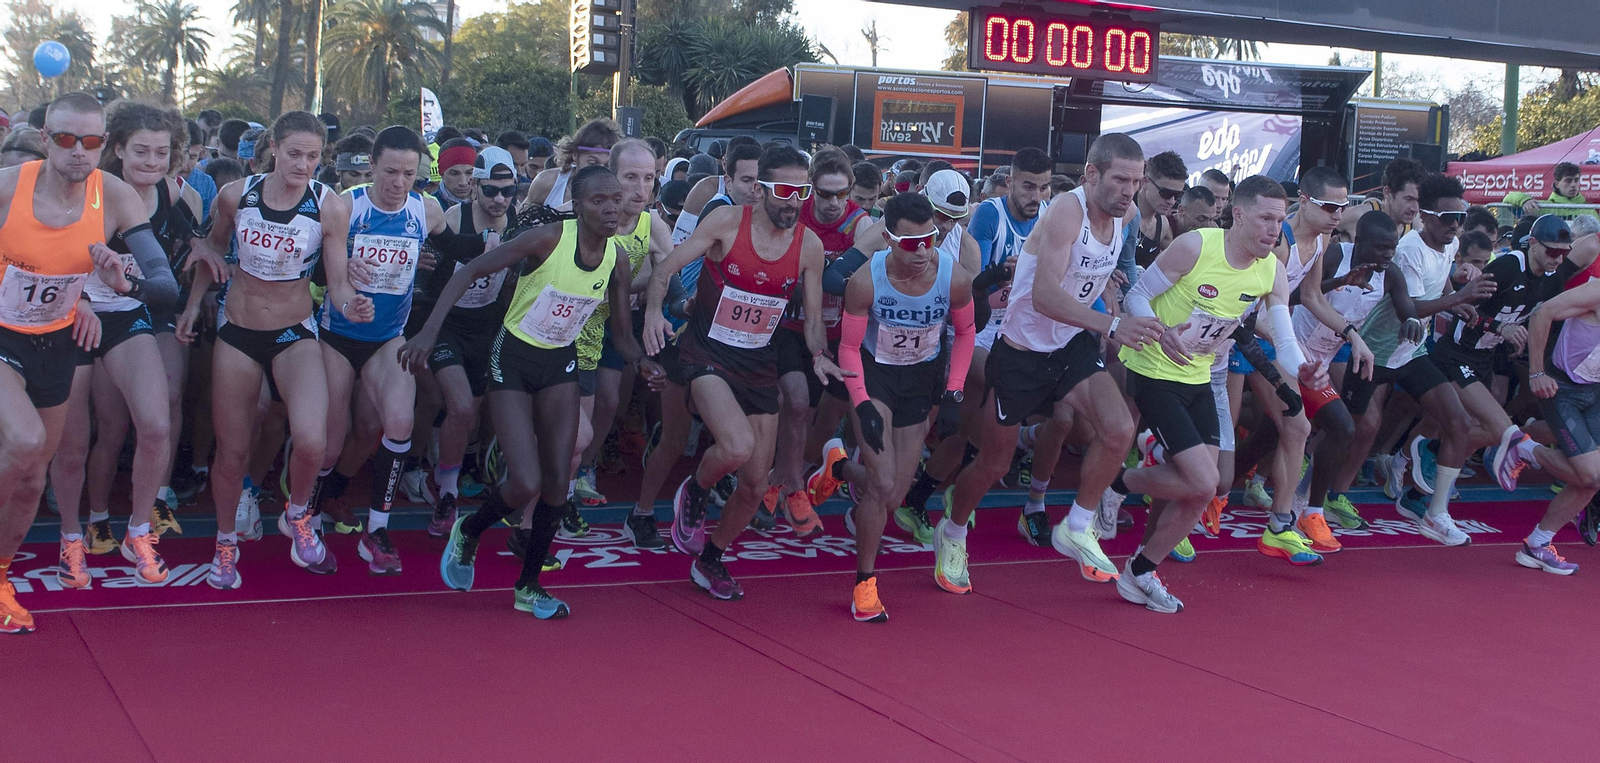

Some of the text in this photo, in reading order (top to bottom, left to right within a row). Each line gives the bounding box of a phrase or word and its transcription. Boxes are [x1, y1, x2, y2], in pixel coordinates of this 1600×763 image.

[986, 16, 1151, 74] 00 00 00
[878, 76, 916, 85] portos
[877, 85, 964, 95] www.sonorizacionesportos.com
[1197, 117, 1240, 160] edp
[241, 228, 295, 253] 12673
[357, 246, 408, 265] 12679
[23, 284, 59, 304] 16
[1079, 281, 1094, 298] 9
[552, 304, 574, 318] 35
[731, 305, 762, 325] 913
[880, 305, 945, 324] nerja
[275, 334, 301, 343] adidas
[893, 334, 920, 348] 21
[1200, 324, 1225, 340] 14
